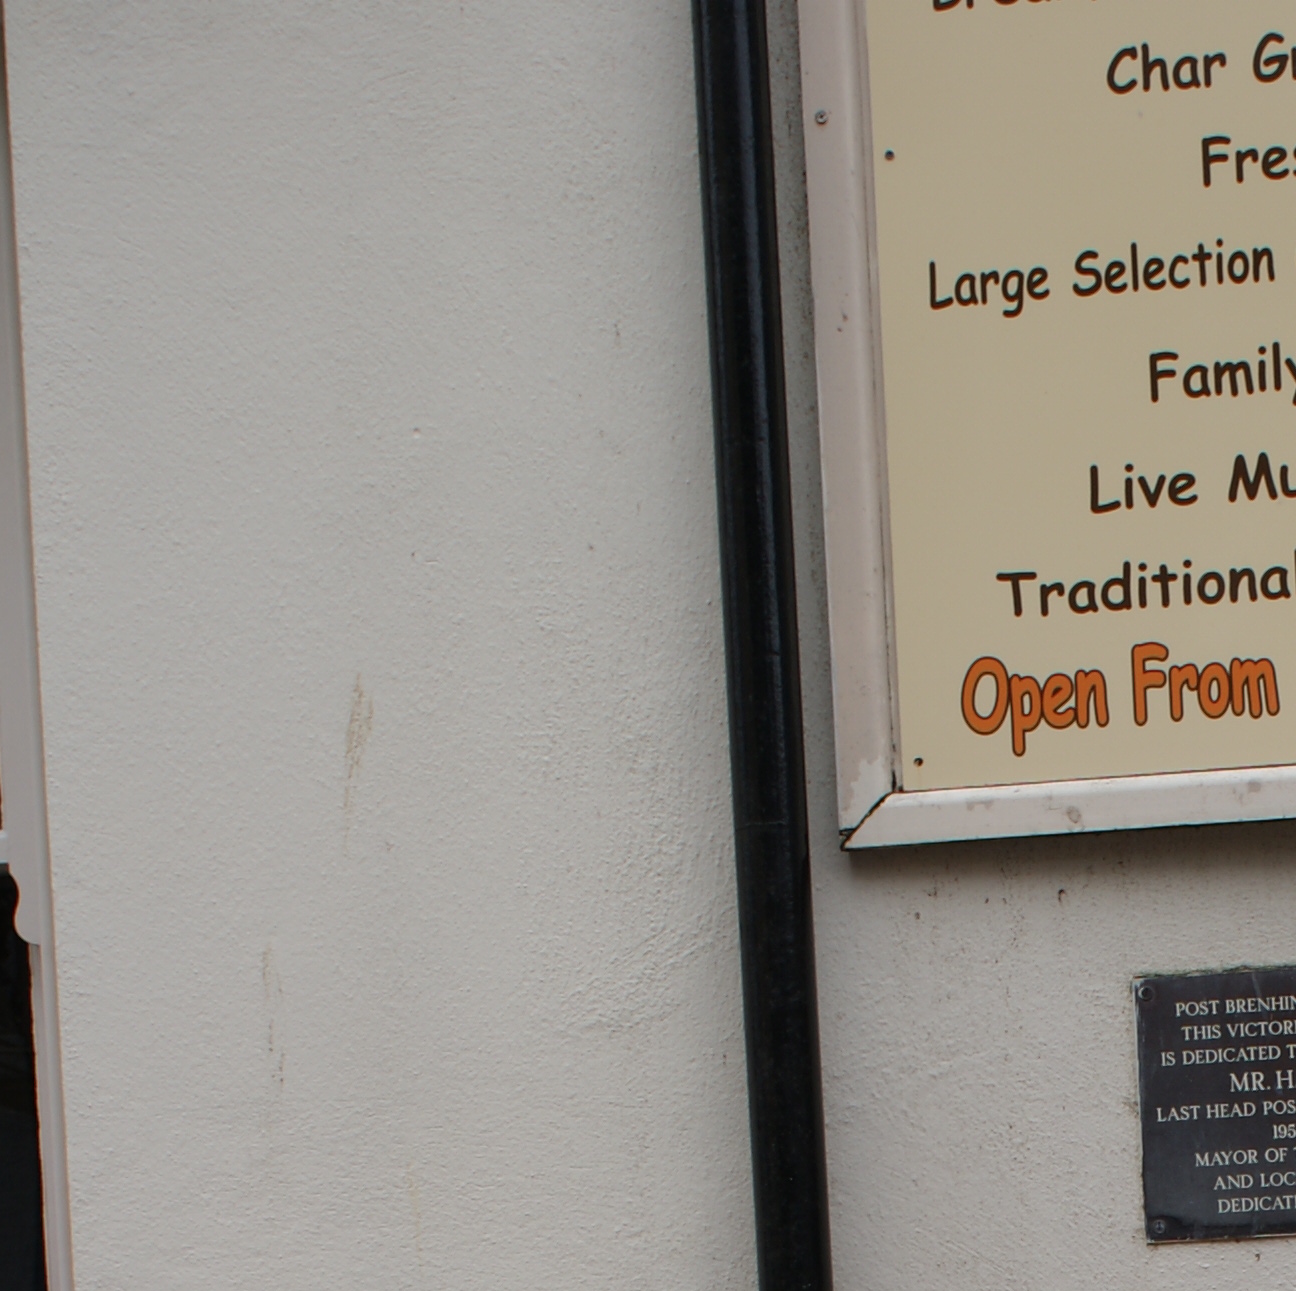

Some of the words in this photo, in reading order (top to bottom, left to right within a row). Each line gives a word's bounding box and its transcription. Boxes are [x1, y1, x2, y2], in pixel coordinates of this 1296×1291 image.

[1106, 43, 1227, 95] Char
[929, 262, 1050, 318] Large
[1072, 238, 1275, 297] Selection
[1090, 464, 1198, 514] Live
[961, 658, 1109, 756] Open
[1131, 643, 1279, 726] From
[1175, 999, 1220, 1018] POST
[1180, 1024, 1222, 1042] THIS
[1160, 1051, 1176, 1067] IS
[1181, 1045, 1282, 1066] DEDICATED
[1229, 1071, 1271, 1093] MR.
[1155, 1104, 1201, 1123] LAST
[1205, 1101, 1257, 1120] HEAD
[1194, 1149, 1259, 1168] MAYOR
[1264, 1147, 1289, 1163] OF
[1213, 1173, 1254, 1191] AND
